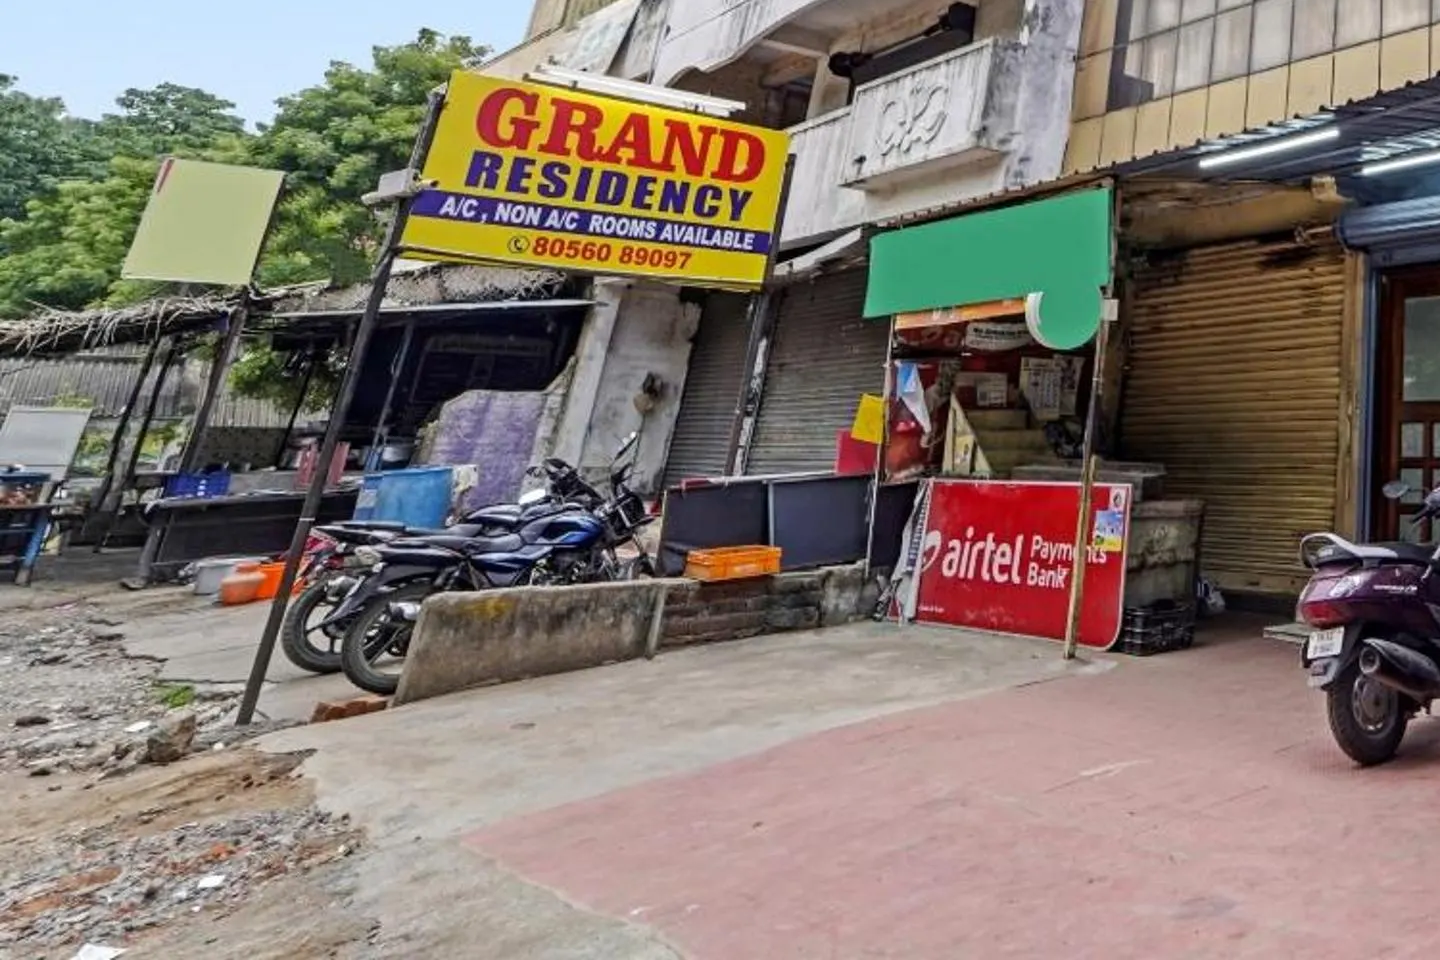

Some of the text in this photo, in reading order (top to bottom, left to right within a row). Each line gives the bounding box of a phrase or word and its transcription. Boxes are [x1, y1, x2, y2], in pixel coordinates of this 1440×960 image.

[475, 87, 766, 184] GRAND
[464, 149, 754, 222] RESIDENCY
[493, 201, 539, 227] NON
[547, 207, 580, 231] A/C
[588, 215, 658, 241] ROOMS
[660, 222, 756, 252] AVAILABLE
[532, 236, 692, 270] 80560 89097
[942, 525, 1024, 584] airtel
[1026, 561, 1070, 589] Bank
